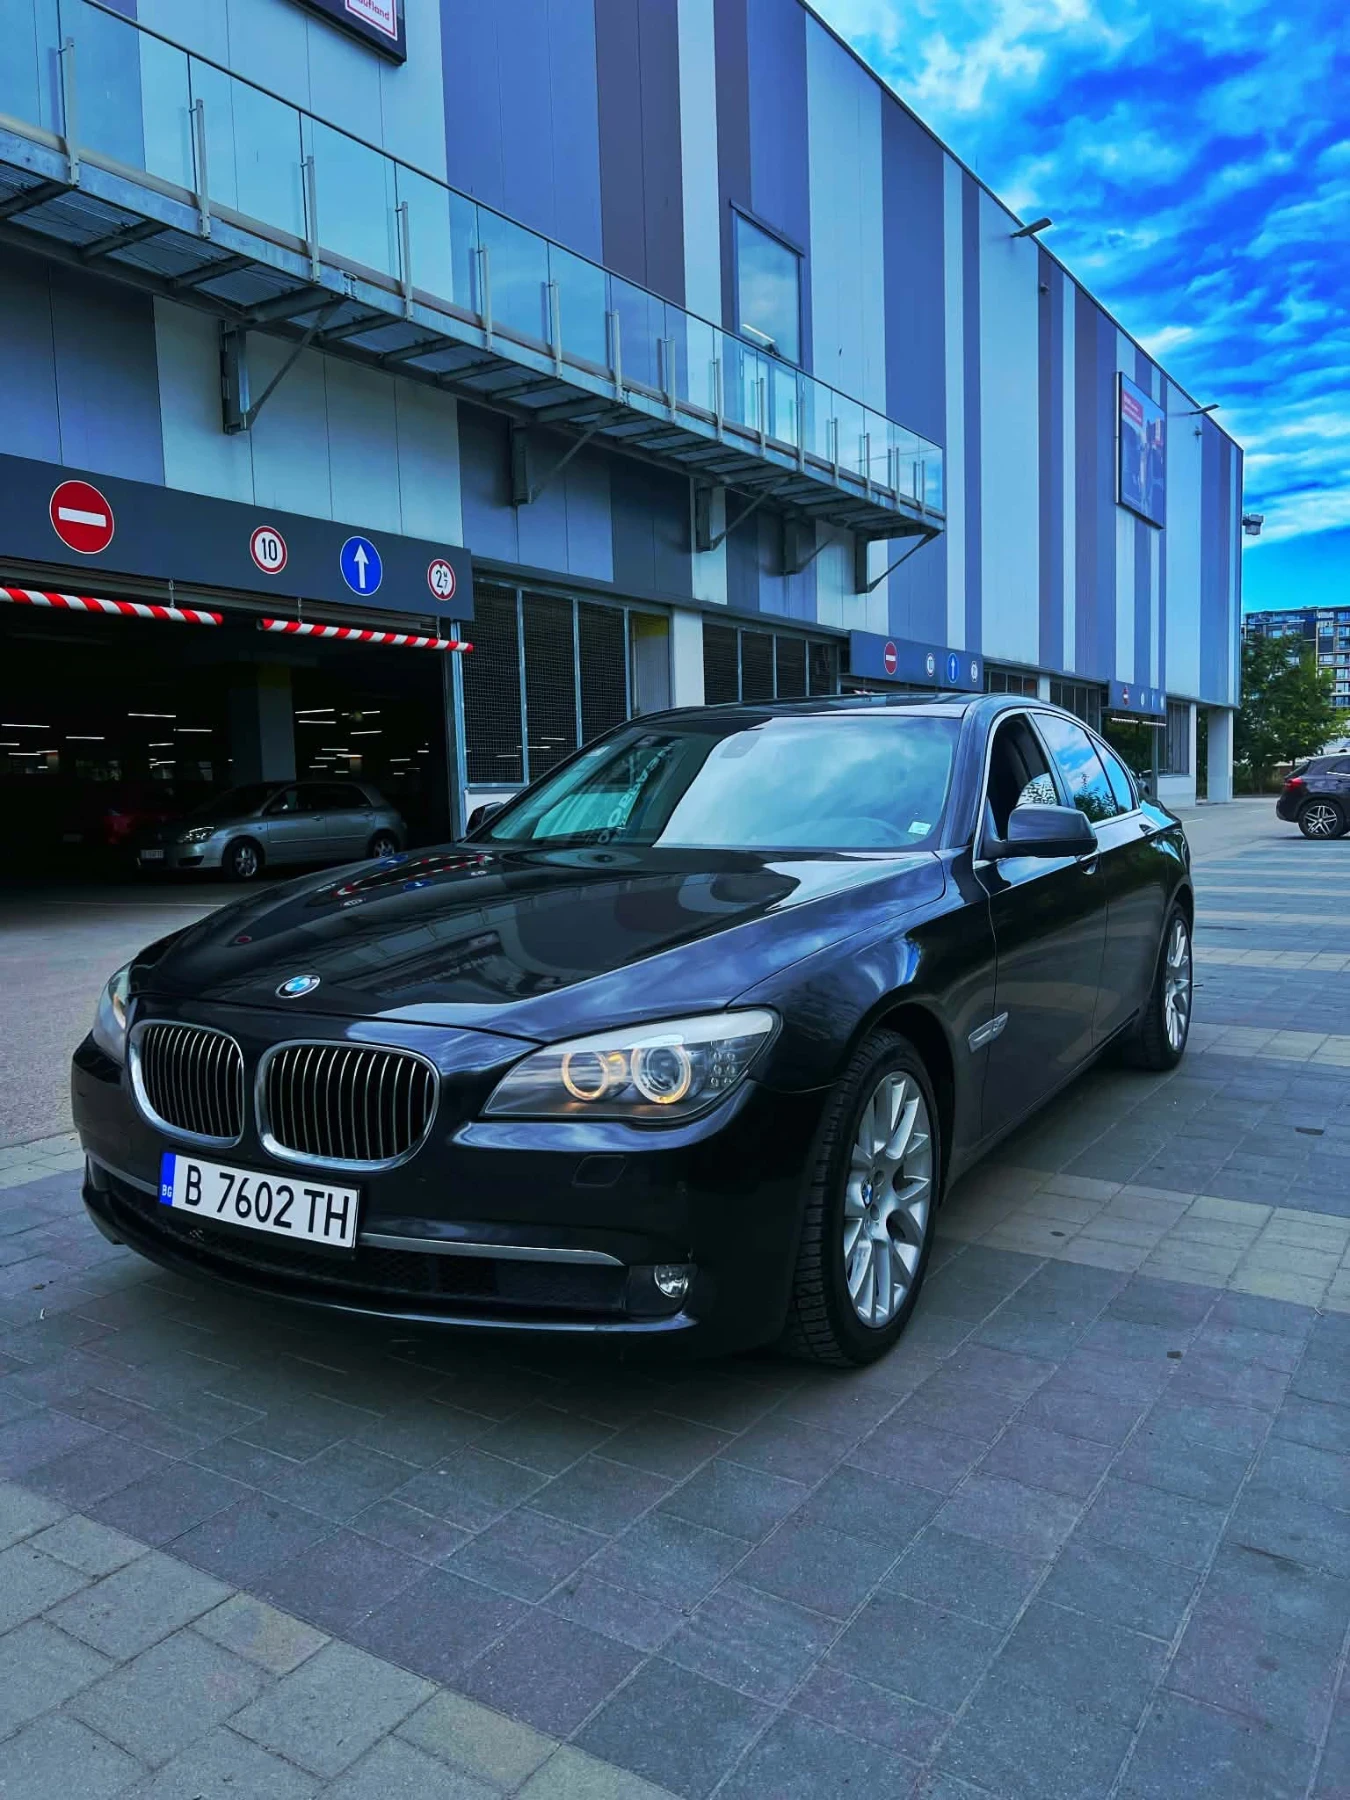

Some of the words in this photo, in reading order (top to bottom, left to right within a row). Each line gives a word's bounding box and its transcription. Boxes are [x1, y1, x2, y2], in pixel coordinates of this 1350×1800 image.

[261, 537, 277, 561] 10
[162, 1184, 173, 1198] BG
[185, 1164, 202, 1207] B
[216, 1171, 294, 1229] 7602
[303, 1188, 350, 1240] TH
